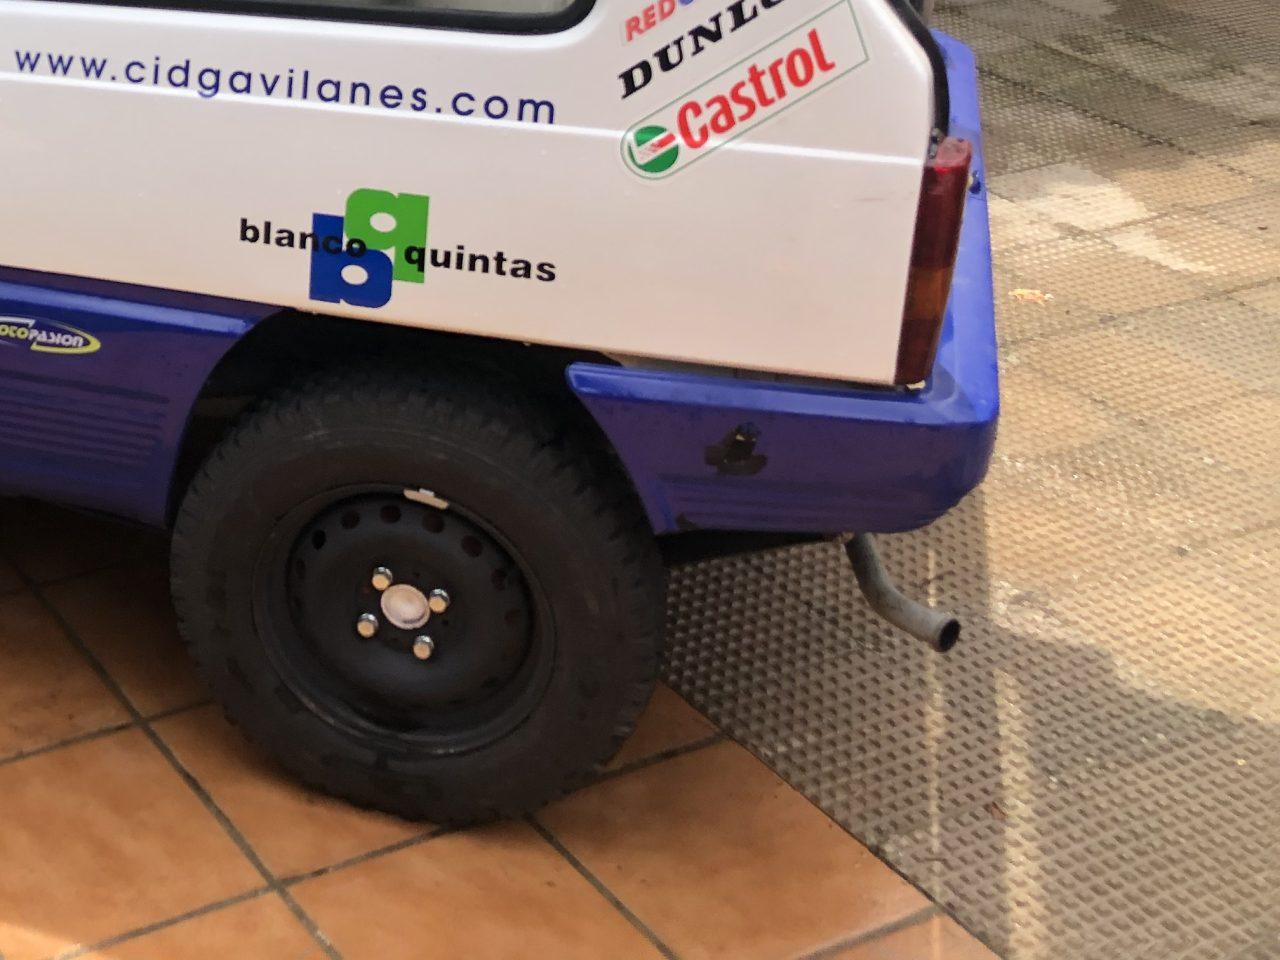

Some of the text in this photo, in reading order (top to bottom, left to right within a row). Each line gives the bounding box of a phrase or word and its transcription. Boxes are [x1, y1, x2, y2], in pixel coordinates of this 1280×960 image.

[15, 49, 556, 125] www.cidgavilanes.com
[676, 28, 837, 150] Castrol
[239, 217, 557, 283] blanco quintas
